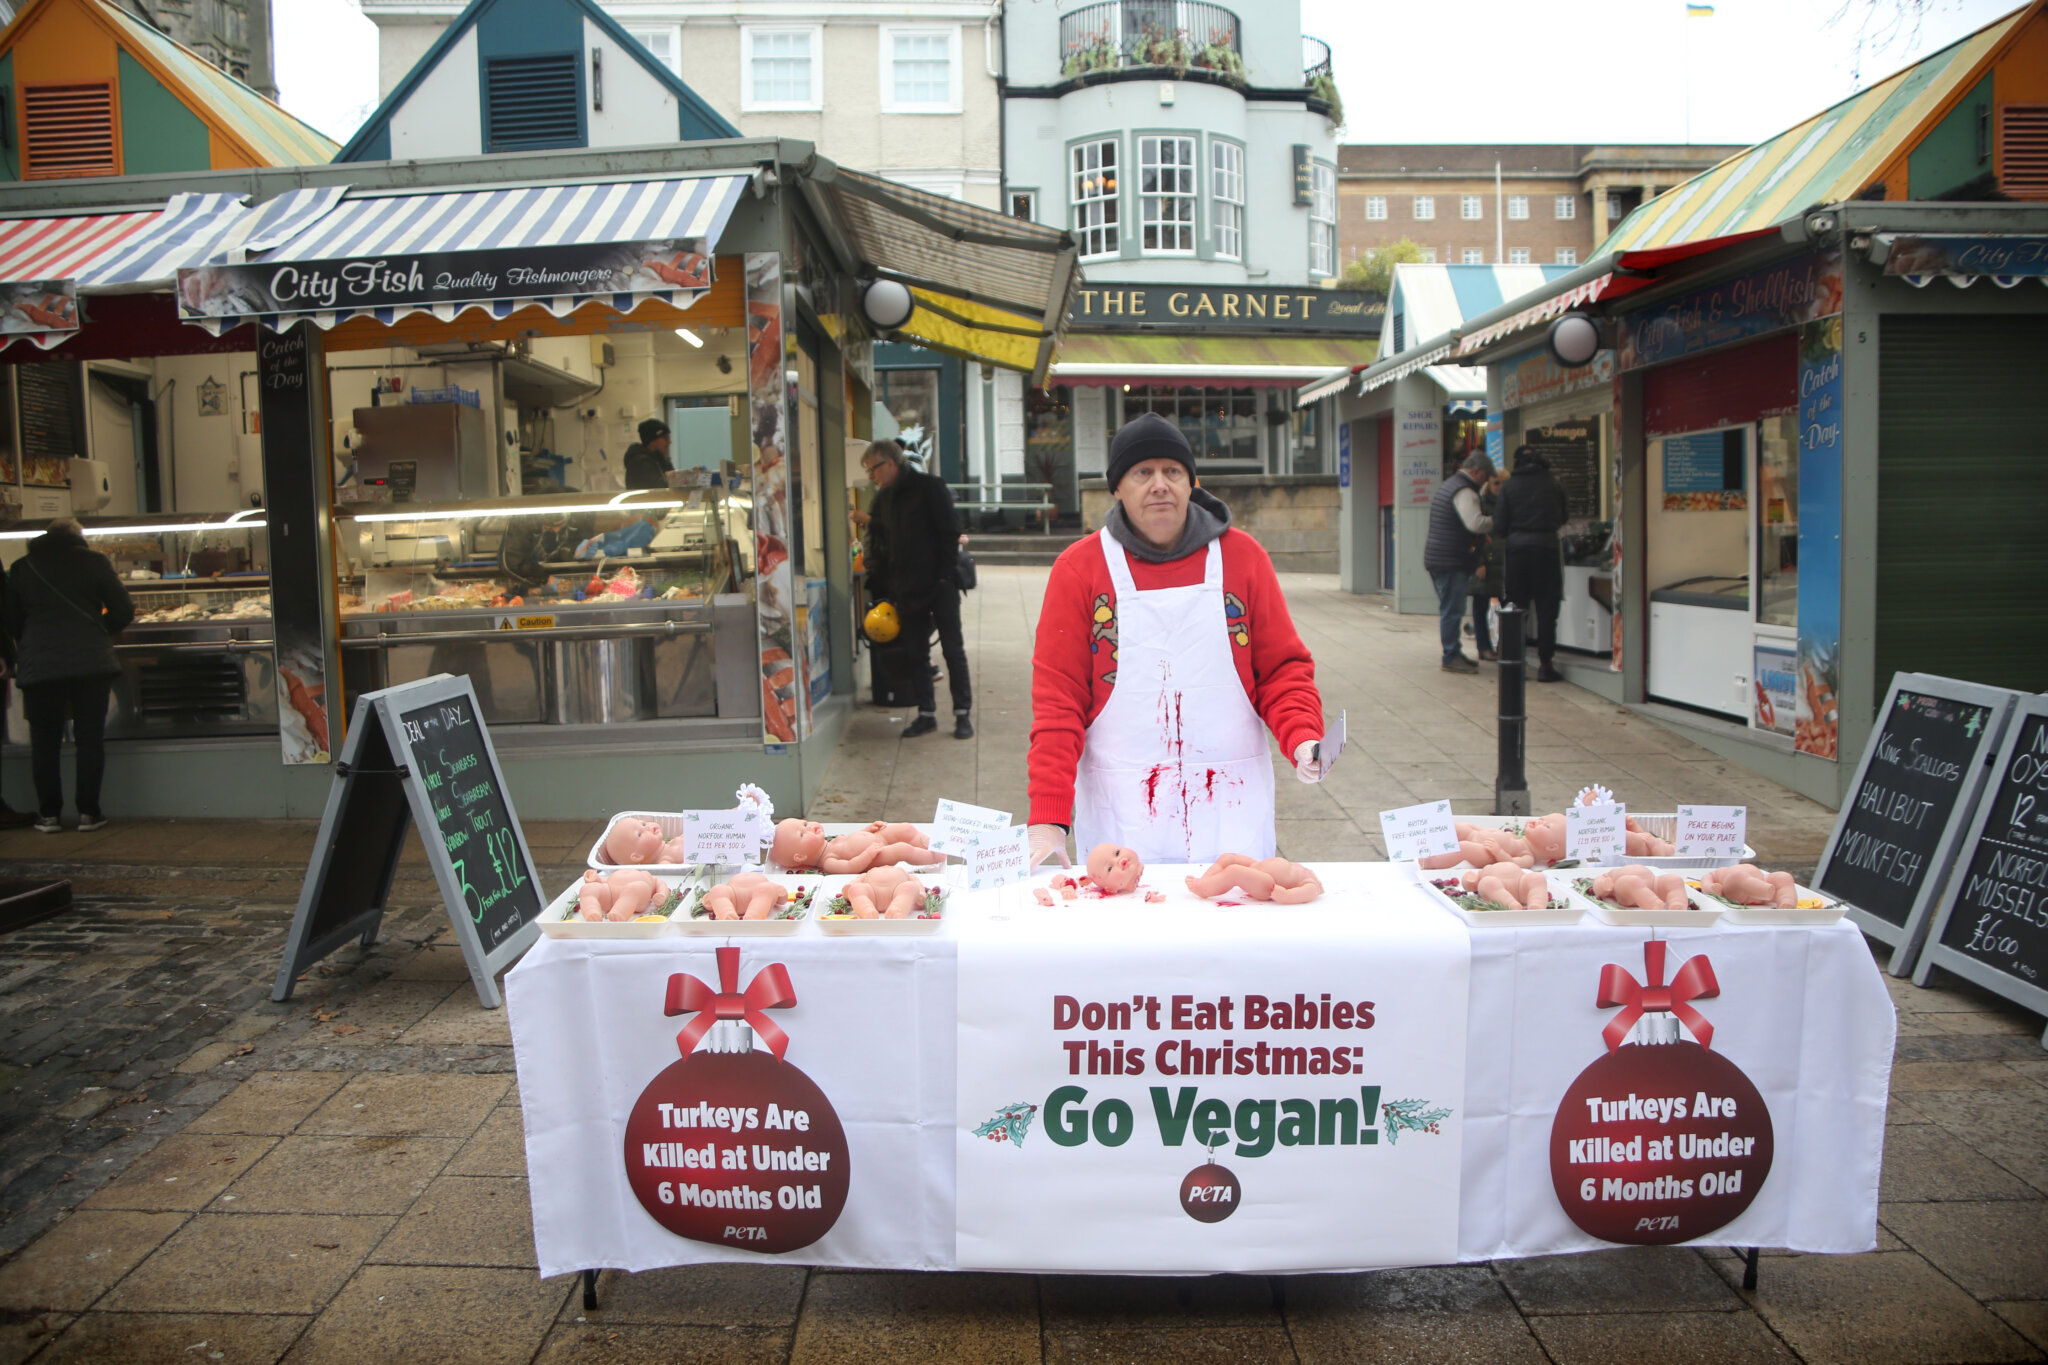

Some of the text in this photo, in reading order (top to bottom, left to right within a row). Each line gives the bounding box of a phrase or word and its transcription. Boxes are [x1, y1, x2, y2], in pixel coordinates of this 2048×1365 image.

[1958, 244, 2014, 270] City
[270, 260, 612, 306] City Fish Quality Fishmongers
[1079, 290, 1147, 316] THE
[1168, 292, 1317, 319] GARNET
[1637, 319, 1664, 354] City
[1665, 296, 1702, 339] Fish
[1708, 292, 1724, 323] &
[1731, 265, 1815, 318] Shellfish
[263, 334, 304, 359] Catch
[1858, 331, 1867, 344] 5
[266, 371, 304, 389] Day
[1801, 353, 1838, 398] Catch
[1408, 410, 1433, 419] SHOE
[1808, 393, 1832, 420] of the
[1403, 422, 1439, 431] REPAIRS
[1803, 422, 1837, 450] Day
[1403, 468, 1440, 476] CUTTING
[520, 618, 552, 626] Caution
[402, 720, 425, 744] DEAL
[423, 748, 477, 791] WHOLE SEABASS
[1875, 732, 1960, 781] KING SCALLOPS
[434, 780, 493, 823] WHOLE SEABREAM
[1857, 780, 1934, 829] HALIBUT
[2009, 792, 2035, 828] 12
[440, 808, 494, 852] RAINBOW TROUT
[1684, 833, 1737, 842] ON YOUR PLATE
[1687, 820, 1736, 830] PEACE BEGINS
[975, 855, 1023, 874] ON YOUR PLATE
[976, 843, 1021, 860] PEACE BEGINS
[1835, 828, 1922, 886] MONKFISH
[452, 859, 483, 924] 3
[487, 827, 527, 898] £12
[1988, 850, 2048, 888] NORFOL
[1965, 874, 2048, 928] MUSSELS
[2020, 963, 2037, 978] KILO
[1171, 995, 1234, 1031] Eat
[1243, 994, 1375, 1031] Babies
[1062, 1040, 1364, 1075] This Christmas:
[658, 1101, 810, 1133] Turkeys Are
[1043, 1085, 1381, 1158] Go Vegan!
[1586, 1091, 1737, 1124] Turkeys Are
[643, 1142, 831, 1171] Killed at Under
[1569, 1132, 1755, 1164] Killed at Under
[658, 1181, 822, 1210] 6 Months Old
[1580, 1169, 1743, 1201] 6 Months Old
